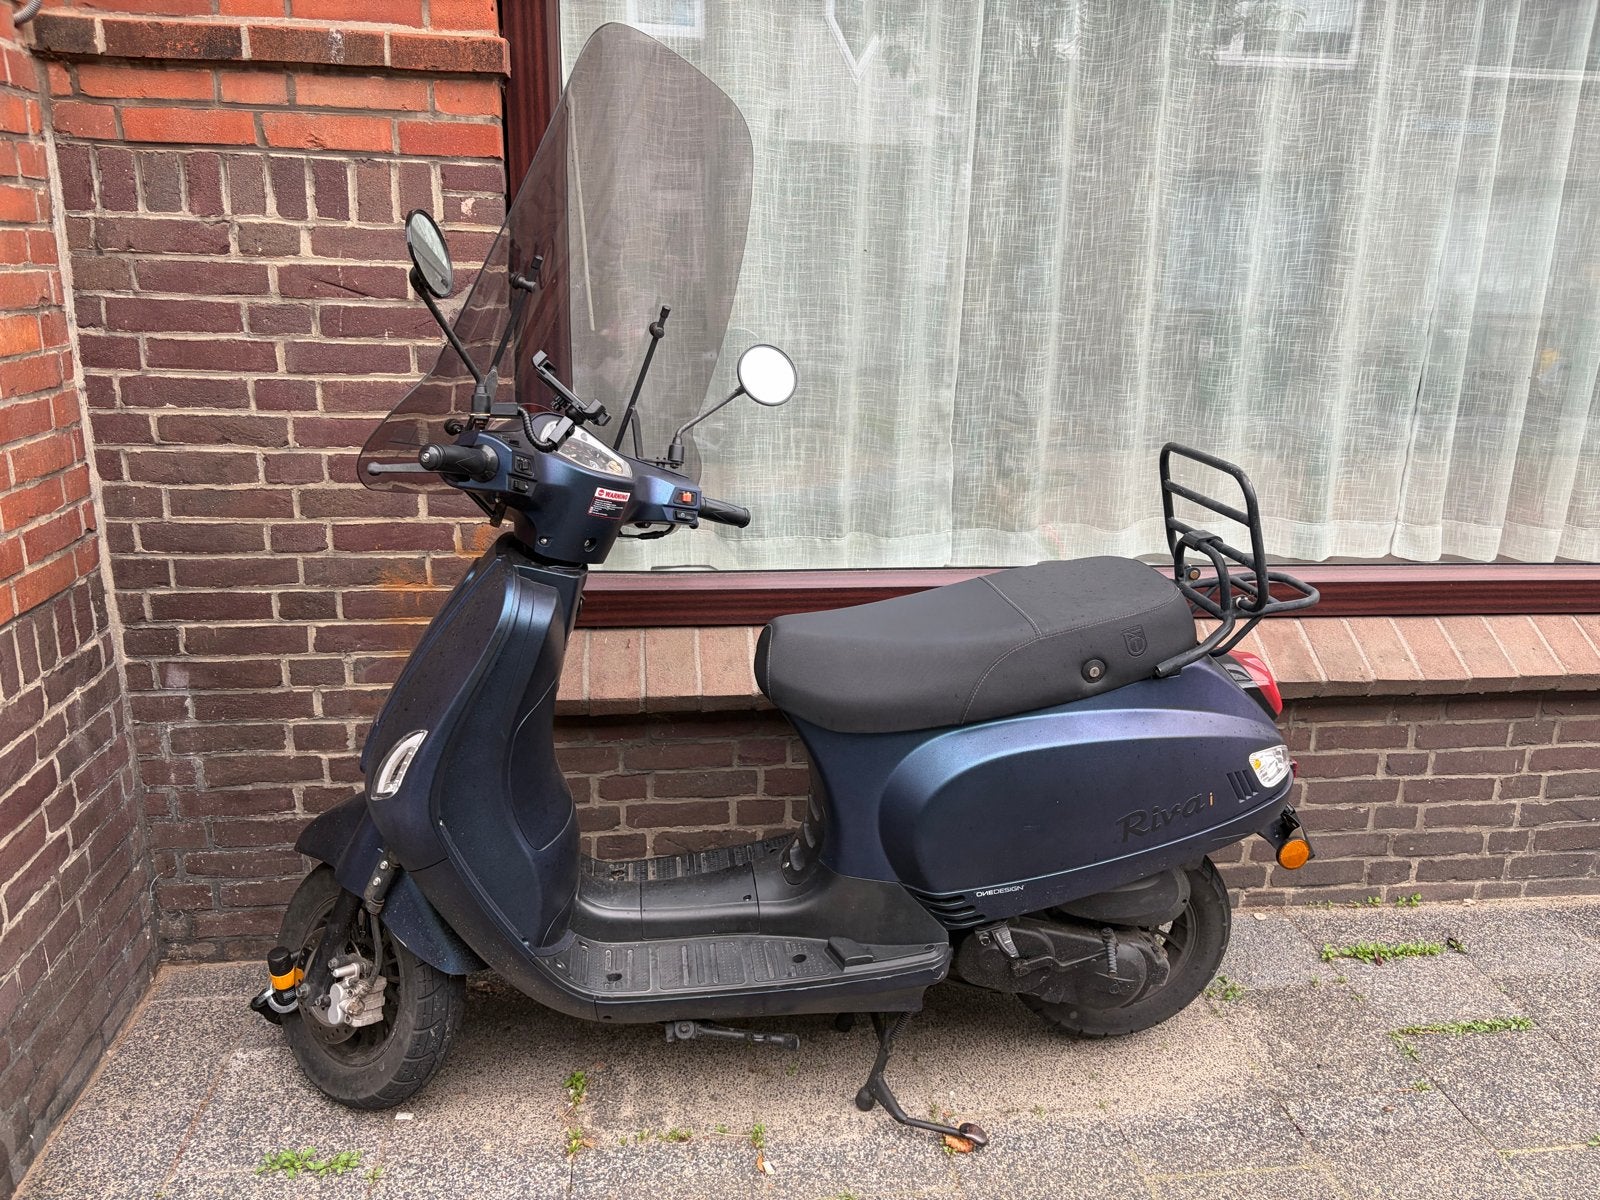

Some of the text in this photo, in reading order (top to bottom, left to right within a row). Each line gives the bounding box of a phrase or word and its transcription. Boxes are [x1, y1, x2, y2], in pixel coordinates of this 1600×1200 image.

[605, 491, 629, 500] WARNING
[1115, 791, 1215, 843] Riva i
[975, 885, 1025, 898] ONEDESIGN
